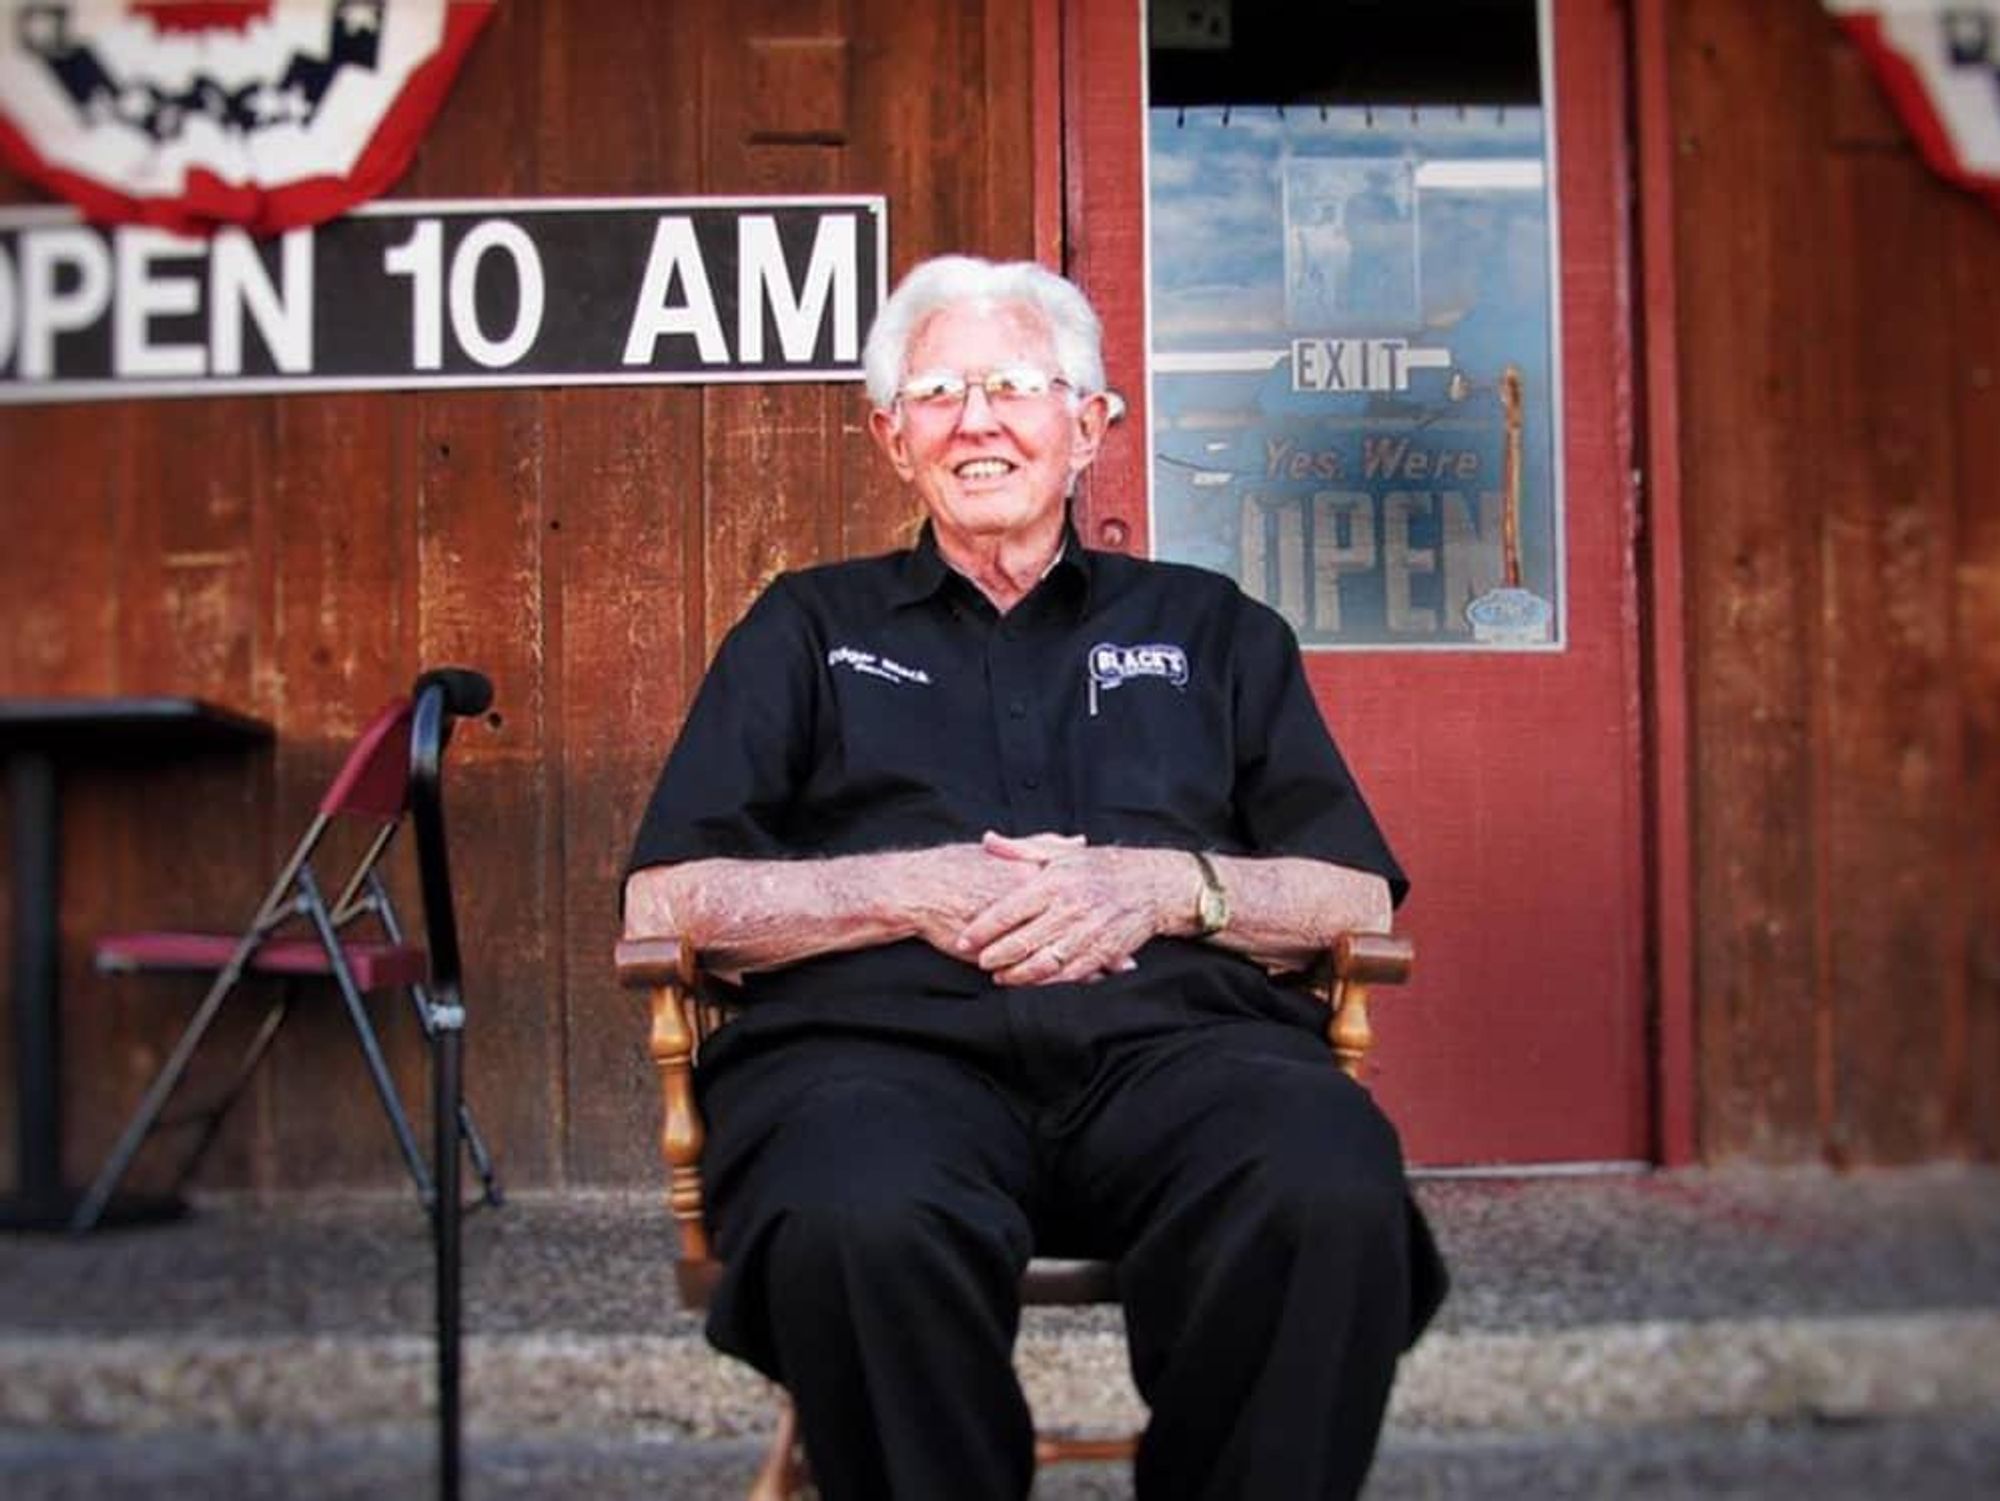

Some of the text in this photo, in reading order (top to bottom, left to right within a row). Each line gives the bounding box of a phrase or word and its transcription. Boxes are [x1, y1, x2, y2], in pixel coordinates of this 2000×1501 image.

[0, 213, 858, 379] PEN 10 AM
[1297, 341, 1404, 388] EXIT
[1240, 487, 1507, 633] OPEN
